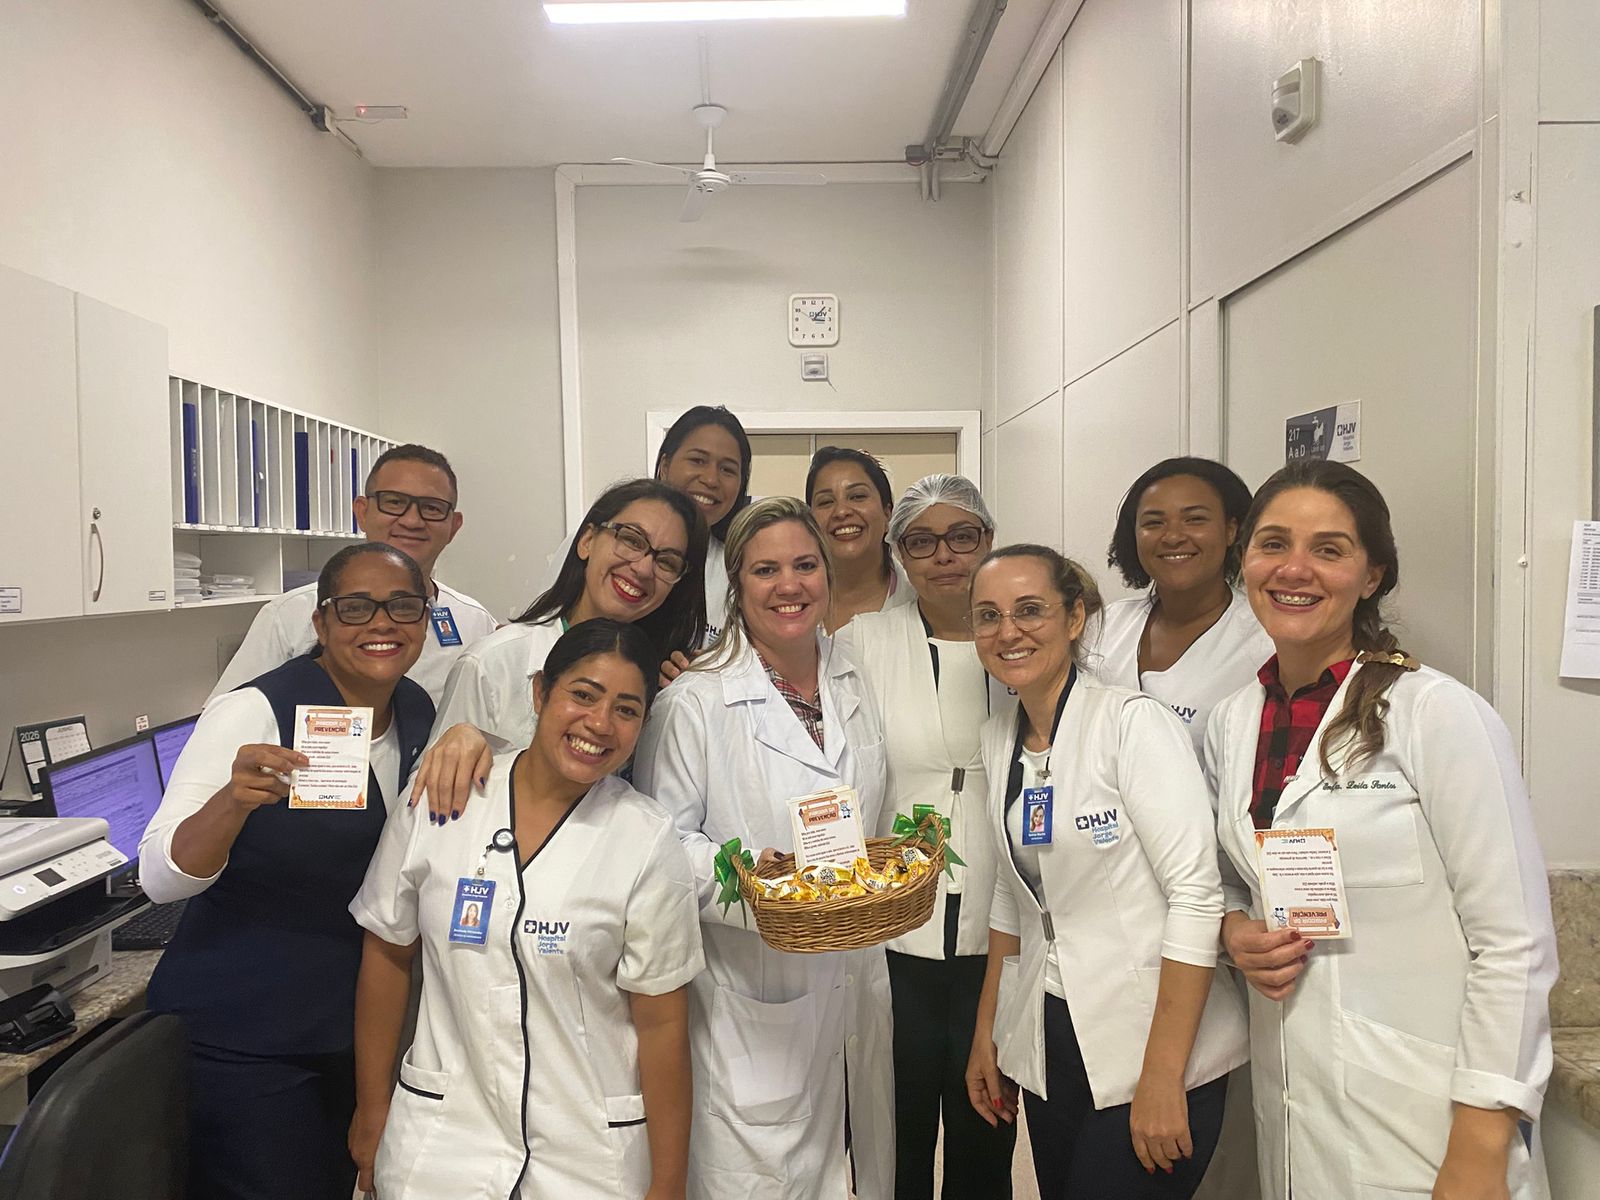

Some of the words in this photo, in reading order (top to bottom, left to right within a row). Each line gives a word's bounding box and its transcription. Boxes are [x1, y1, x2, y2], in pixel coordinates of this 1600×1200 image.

[1288, 427, 1300, 442] 217
[1342, 422, 1357, 435] HJV
[1288, 446, 1294, 459] A
[1294, 448, 1299, 458] a
[1300, 444, 1306, 457] D
[20, 730, 40, 742] 2026
[1346, 781, 1368, 789] Leila
[1089, 809, 1117, 827] HJV
[1091, 822, 1119, 833] Hospital
[470, 886, 489, 895] HJV
[538, 921, 570, 934] HJV
